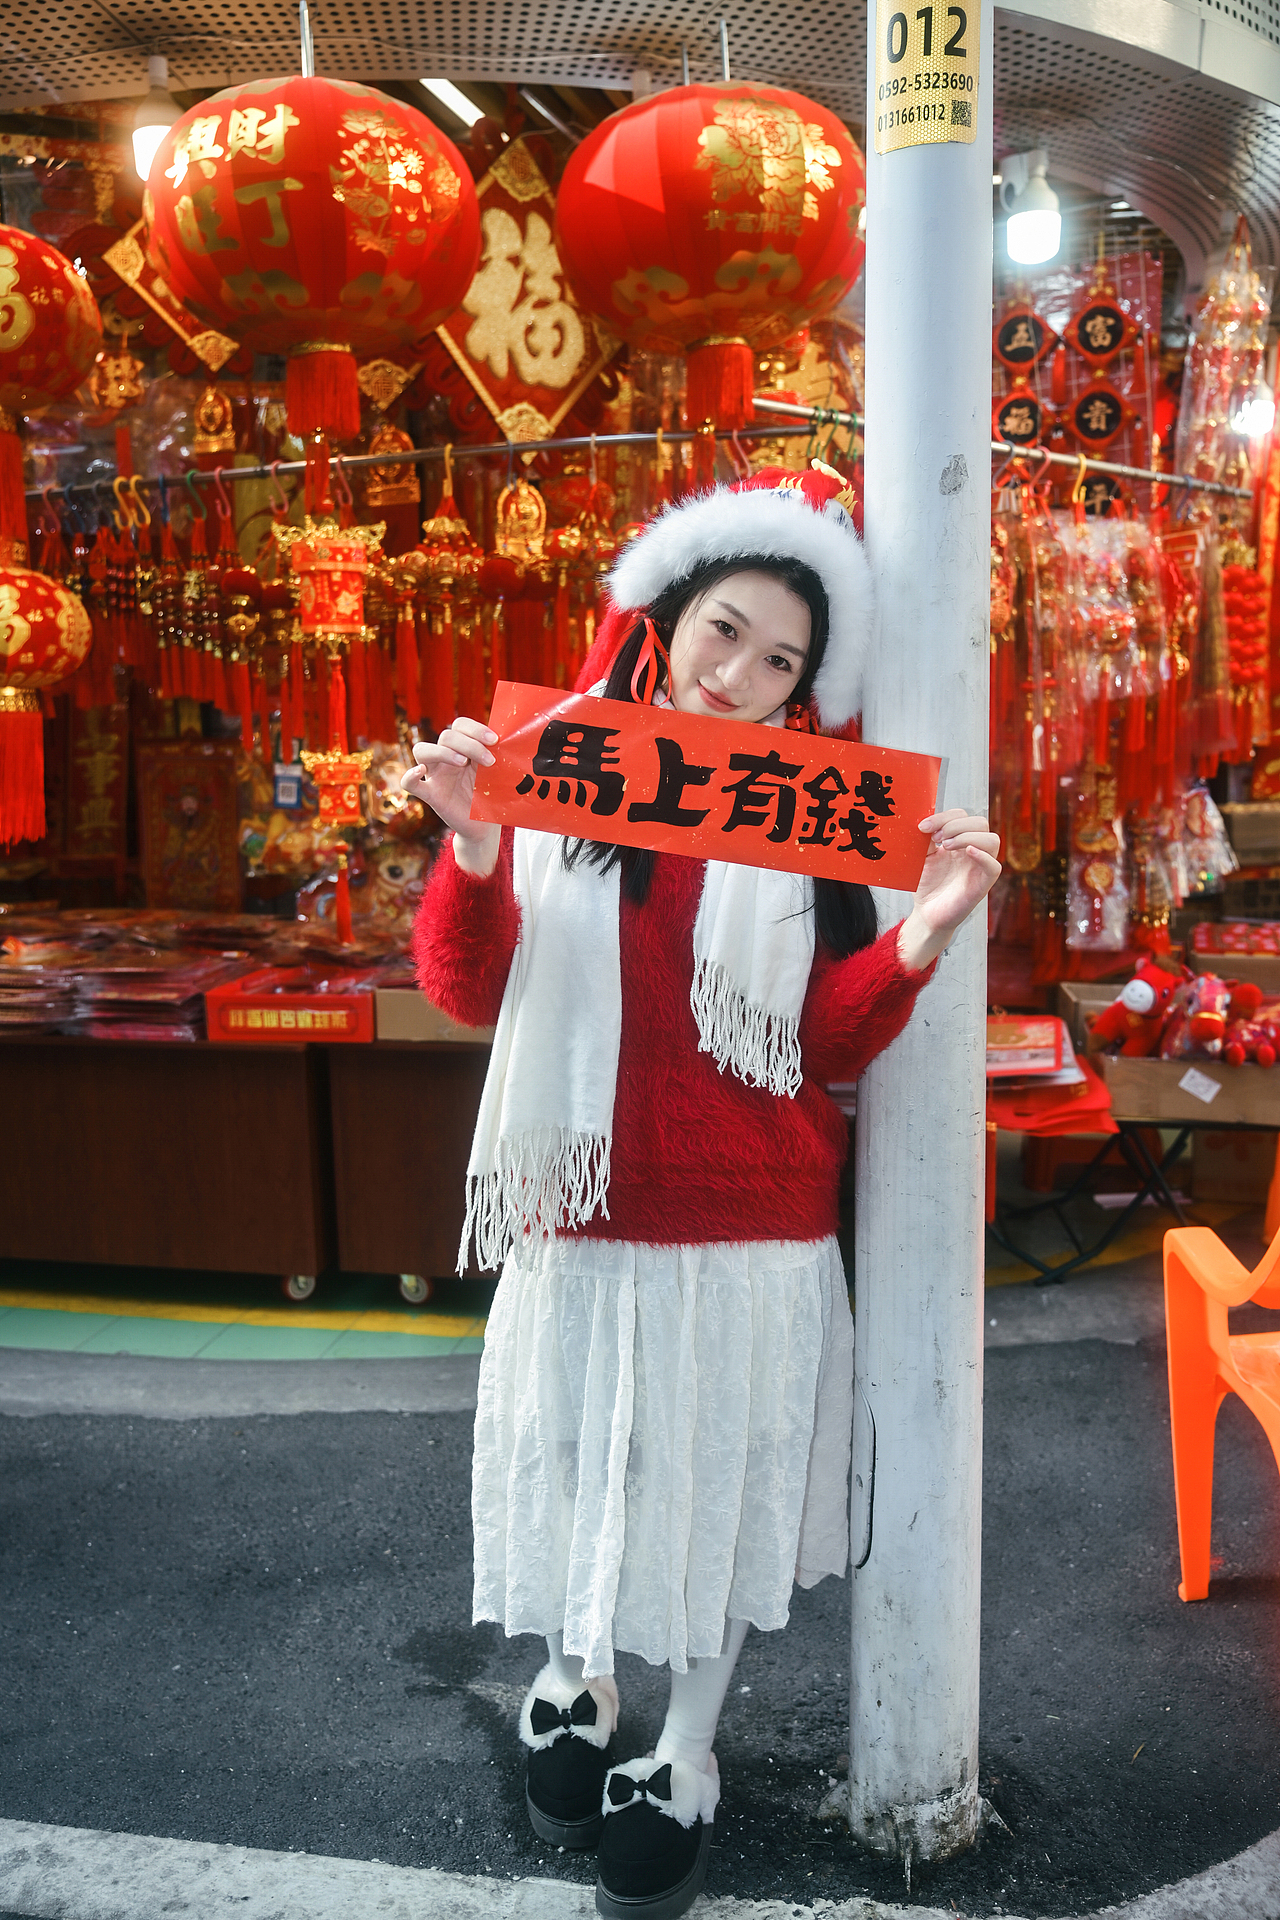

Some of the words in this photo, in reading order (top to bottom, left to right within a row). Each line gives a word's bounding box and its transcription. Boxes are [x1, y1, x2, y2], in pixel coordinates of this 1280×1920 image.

[887, 6, 967, 63] 012
[878, 72, 973, 101] 0592-5323690
[877, 103, 945, 132] 0131661012
[461, 207, 585, 390] 福
[515, 719, 896, 860] 馬上有錢
